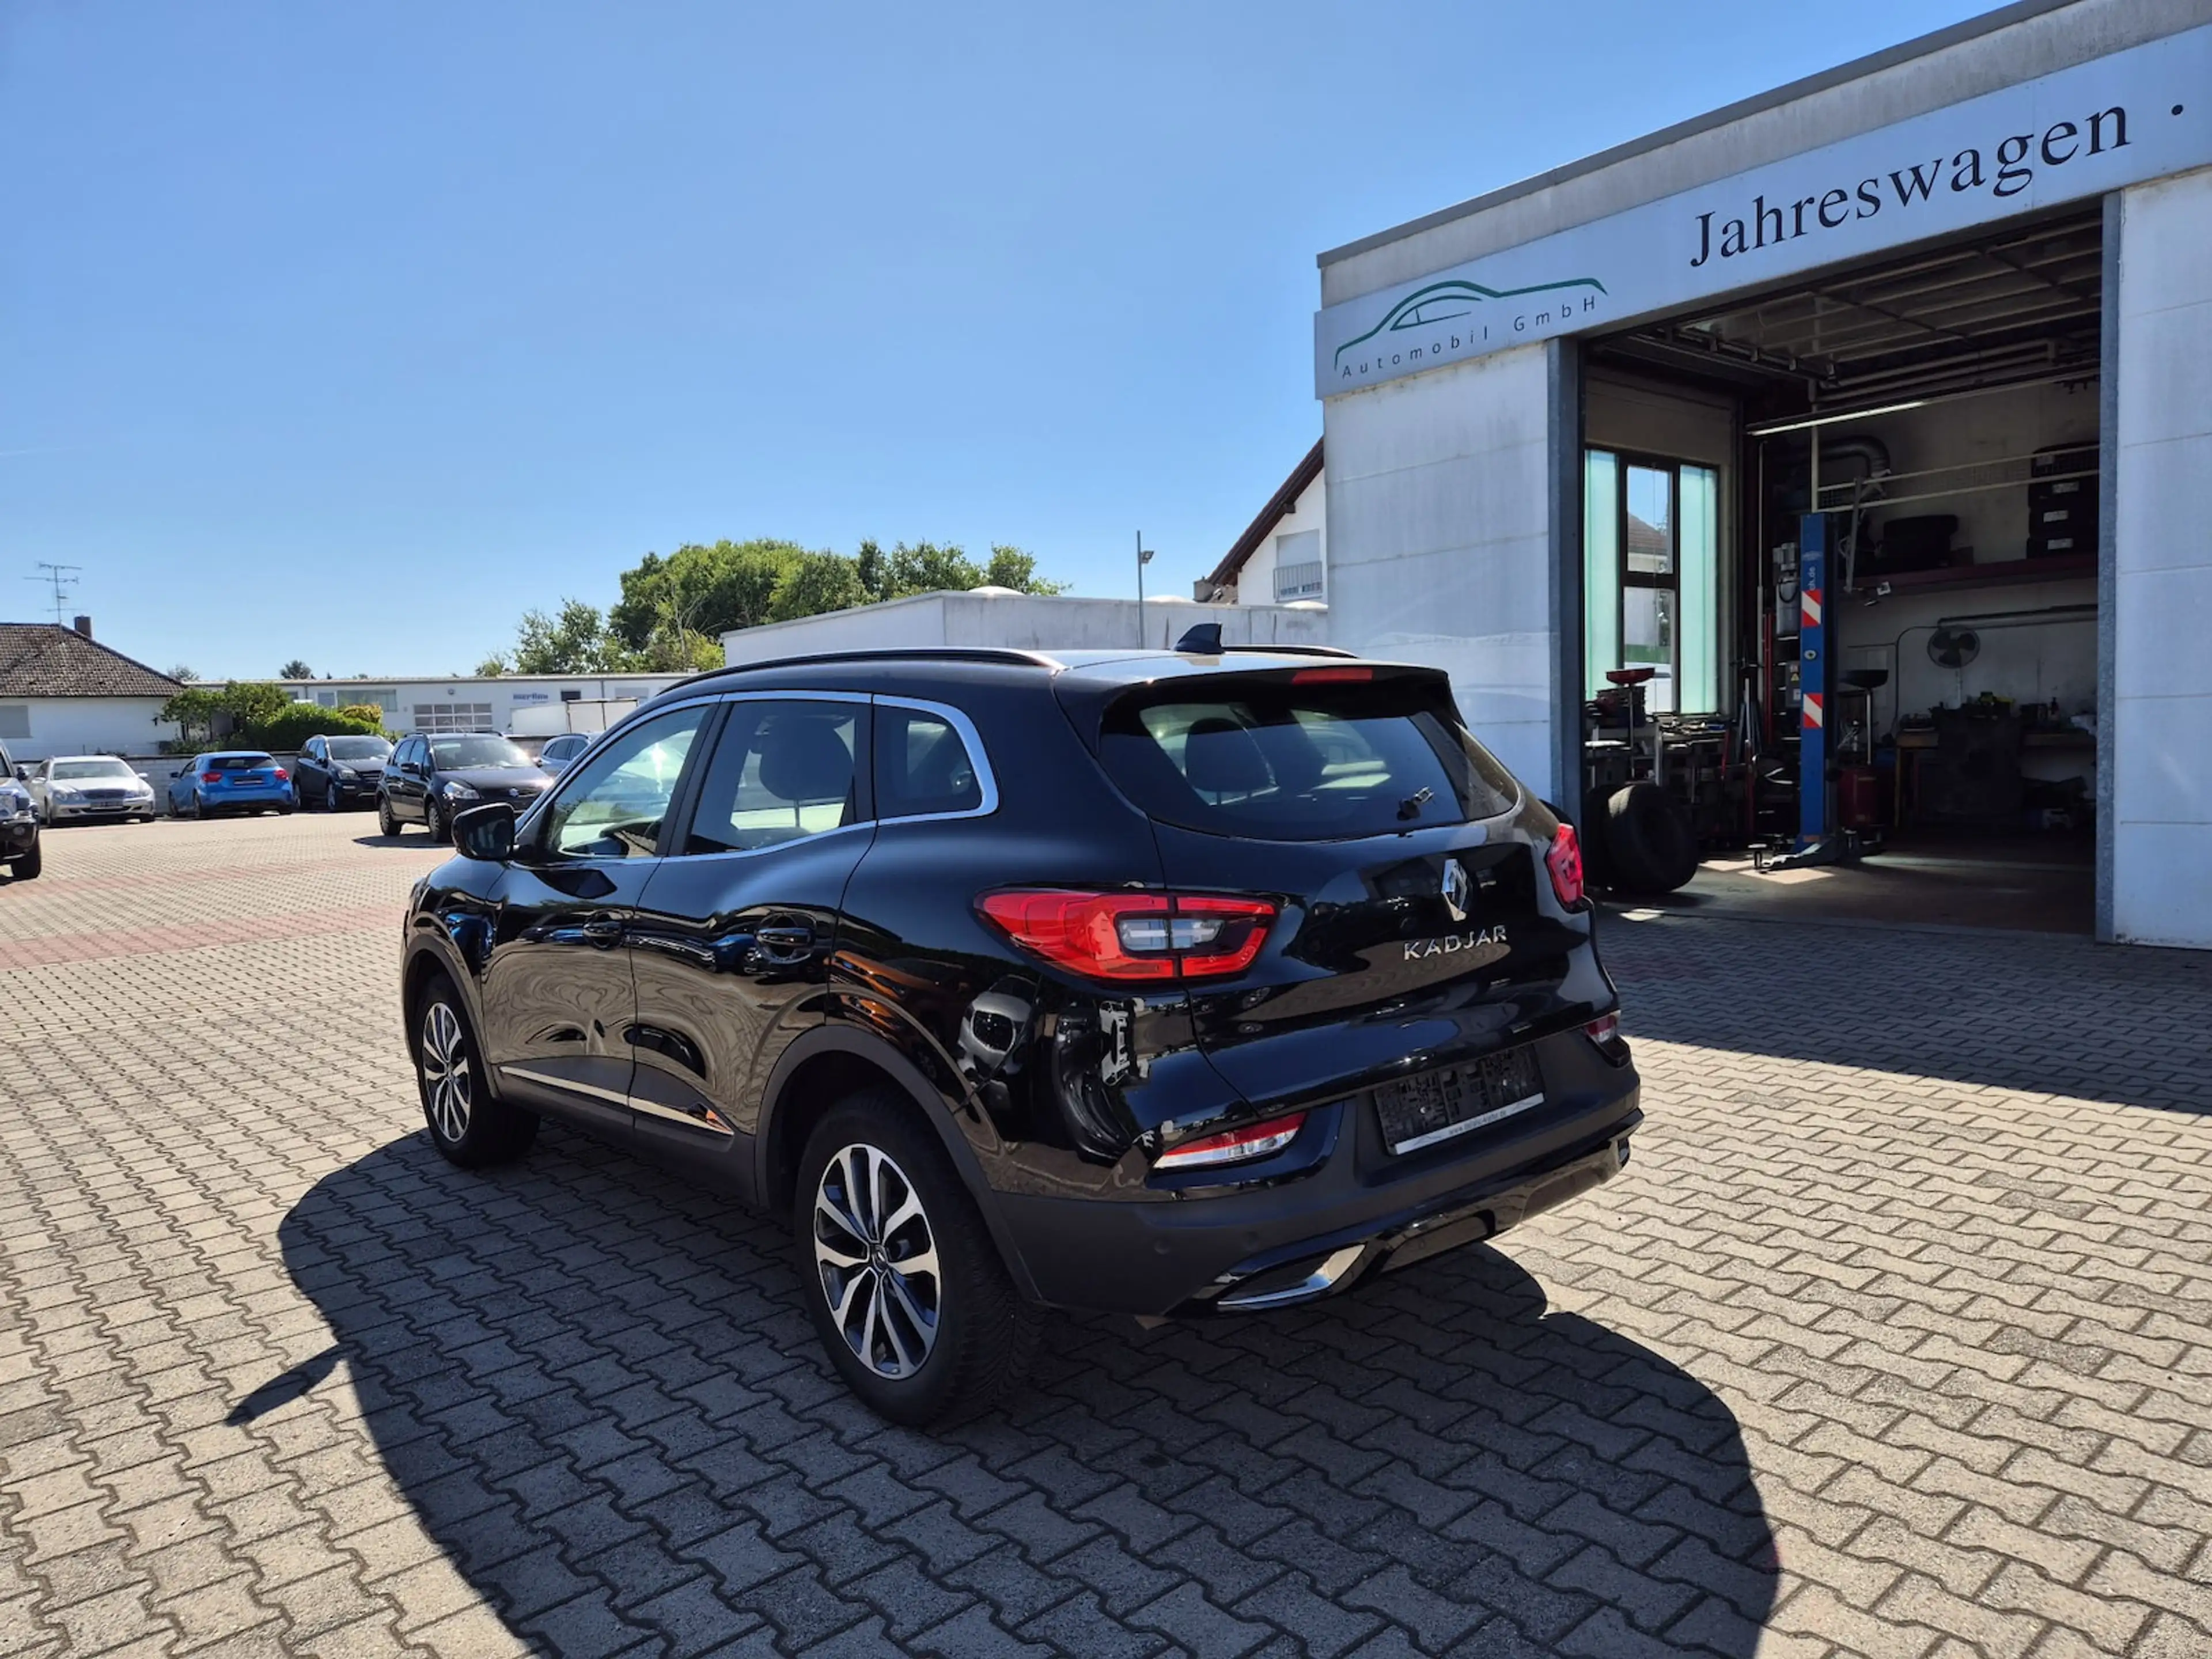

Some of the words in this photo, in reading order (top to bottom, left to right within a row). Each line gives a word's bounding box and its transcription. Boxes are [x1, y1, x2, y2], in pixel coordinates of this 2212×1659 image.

[1690, 104, 2132, 267] Jahreswagen
[1343, 326, 1487, 378] Automobil
[1514, 296, 1594, 331] GmbH
[1404, 925, 1507, 960] KADJAR
